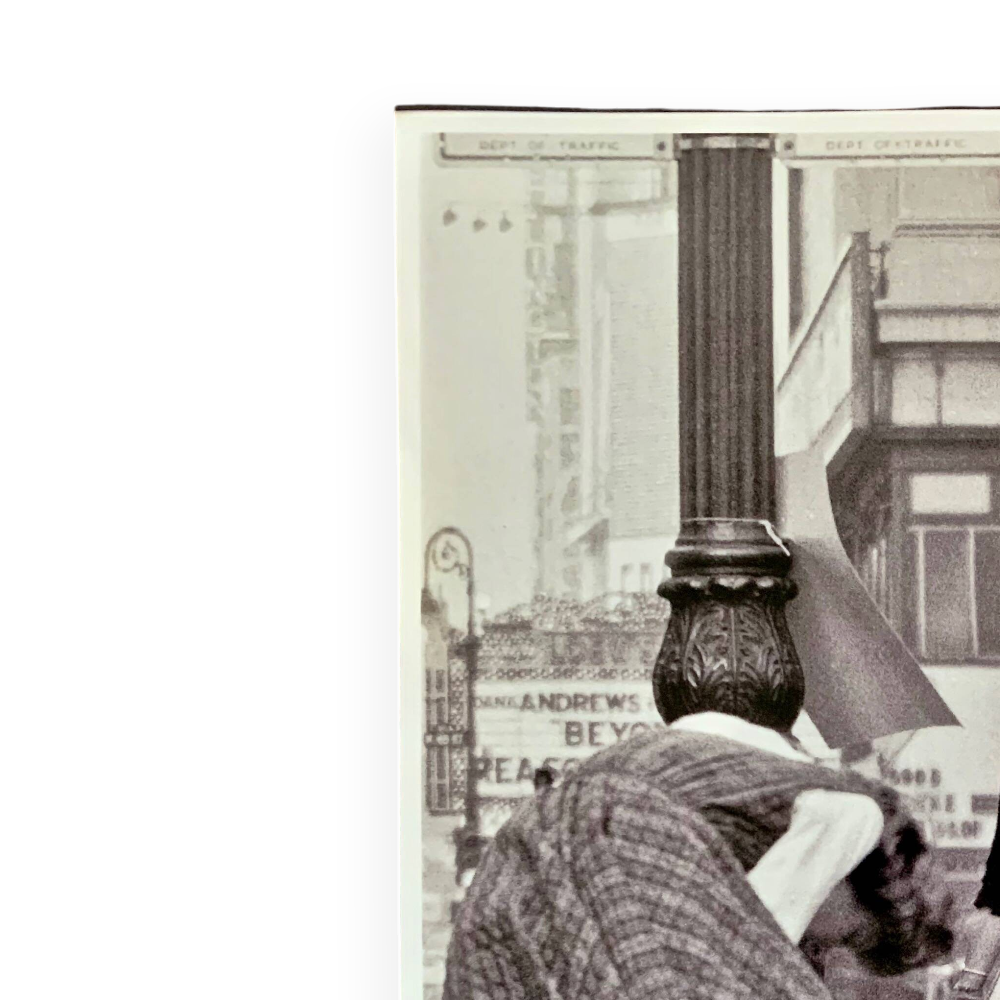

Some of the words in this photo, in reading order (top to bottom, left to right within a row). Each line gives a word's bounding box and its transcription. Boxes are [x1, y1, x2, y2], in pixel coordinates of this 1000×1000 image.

[527, 140, 545, 150] OF
[559, 140, 620, 150] TRAFFIC
[825, 140, 863, 151] DEPT
[904, 138, 967, 150] TRAFFIC
[519, 693, 640, 713] ANDREWS
